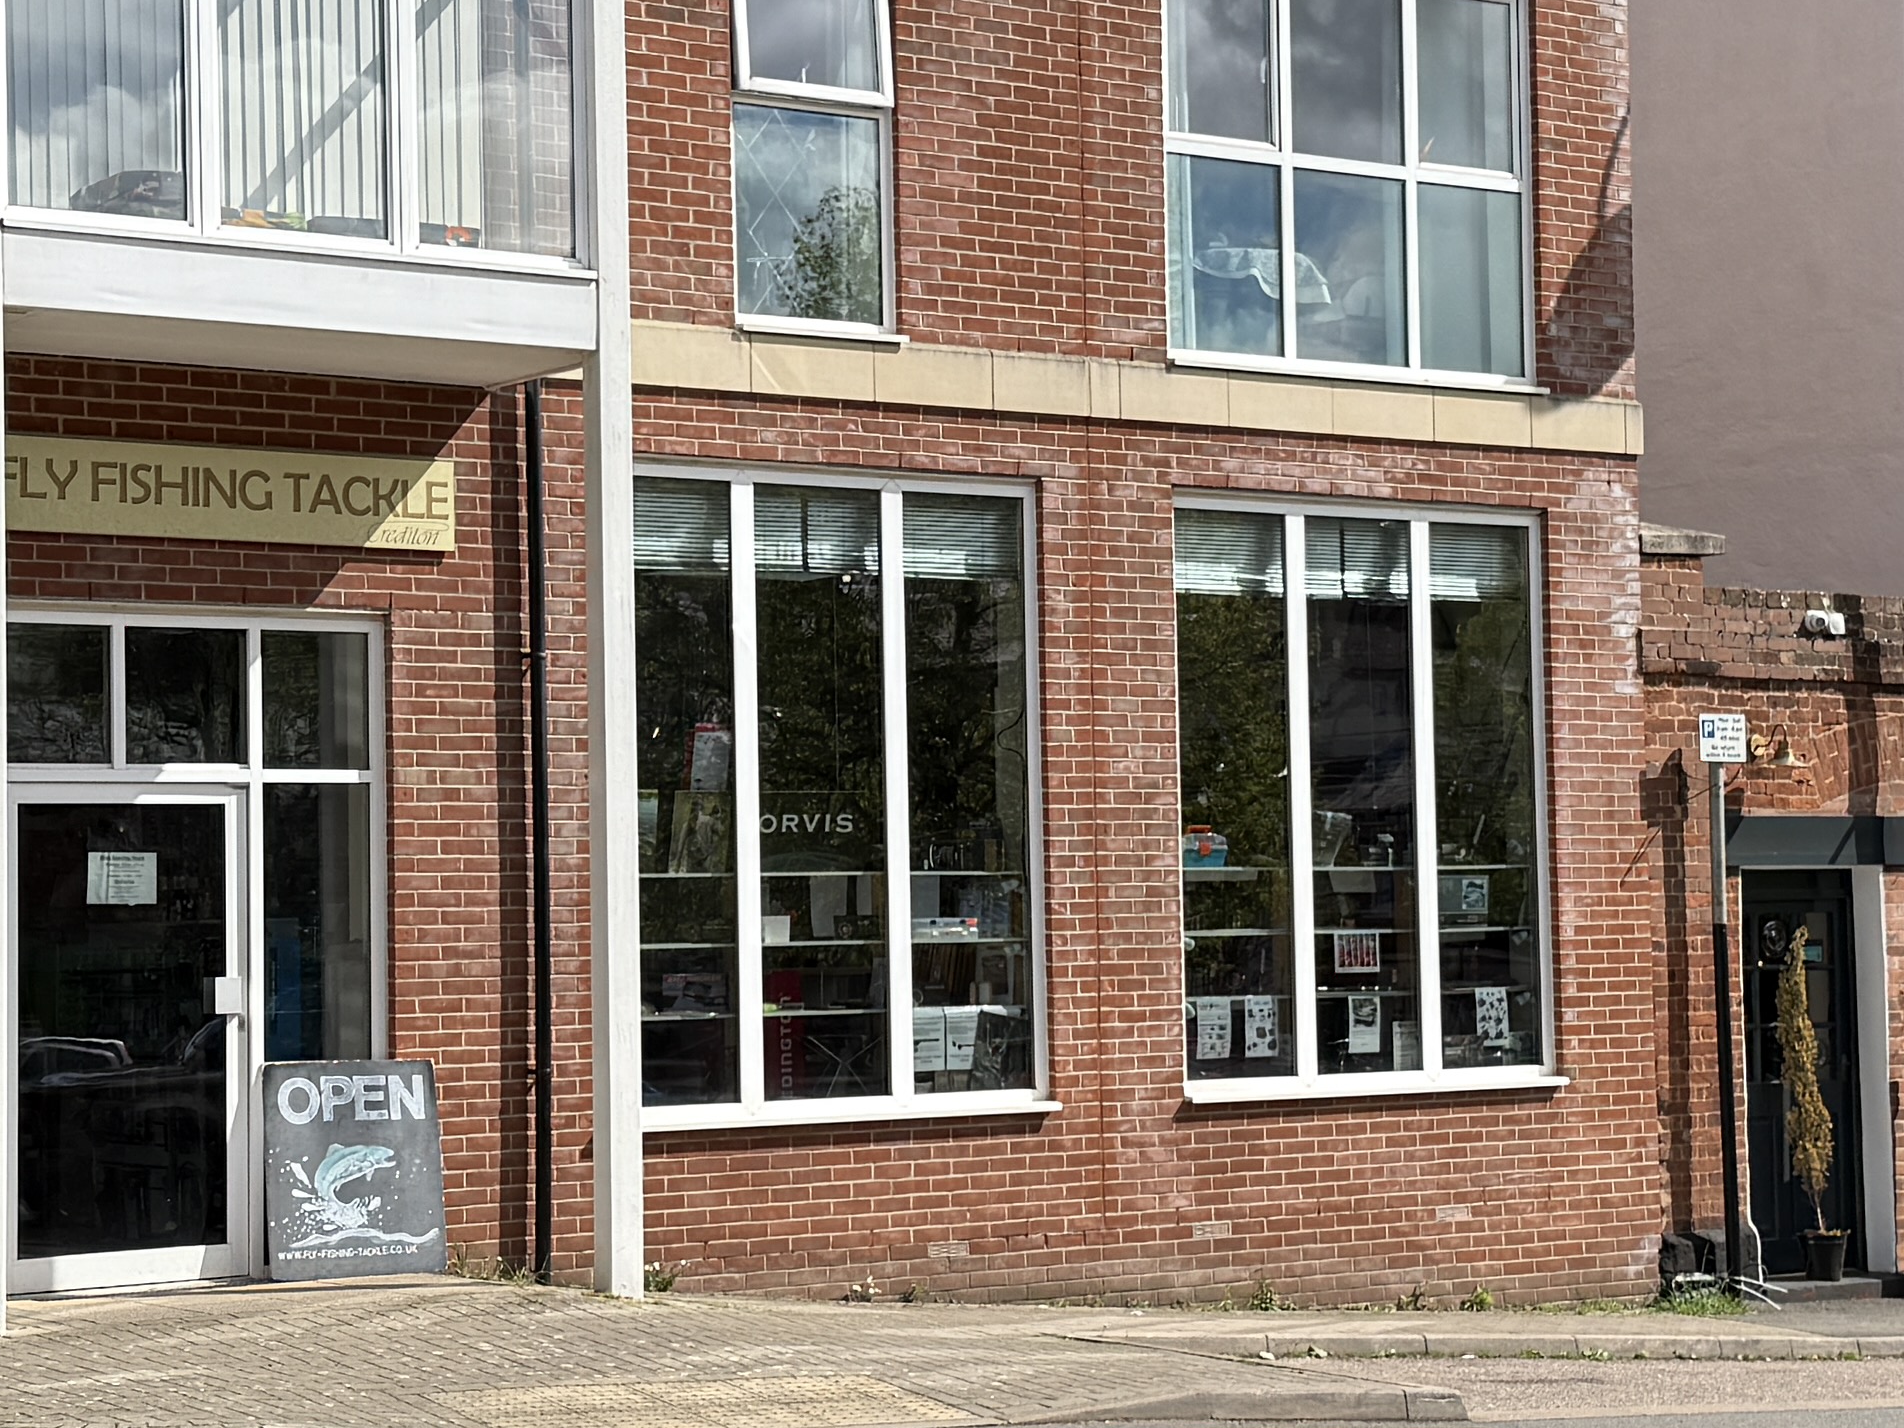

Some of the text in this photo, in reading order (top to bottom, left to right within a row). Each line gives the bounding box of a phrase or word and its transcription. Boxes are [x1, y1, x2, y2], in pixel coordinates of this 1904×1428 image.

[91, 461, 273, 513] FISHING
[283, 472, 449, 520] TACKLE
[760, 814, 853, 833] ORVIS
[277, 1074, 426, 1125] OPEN
